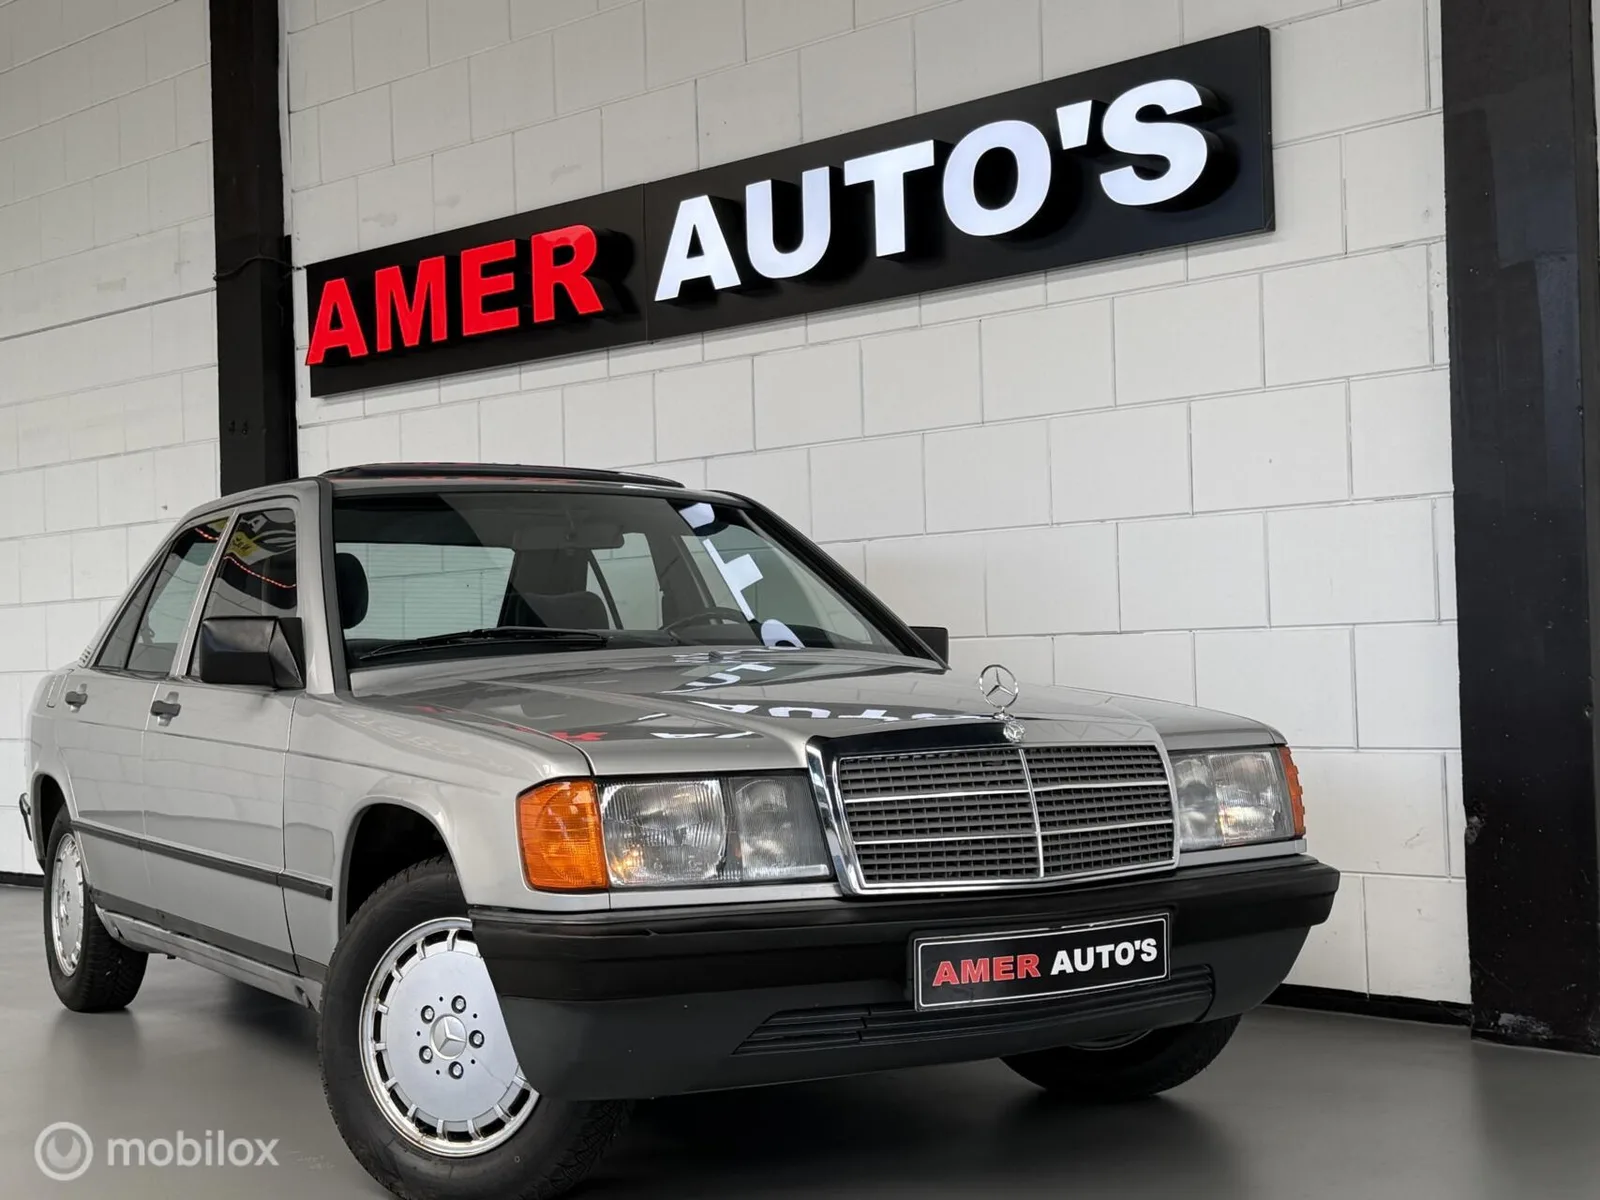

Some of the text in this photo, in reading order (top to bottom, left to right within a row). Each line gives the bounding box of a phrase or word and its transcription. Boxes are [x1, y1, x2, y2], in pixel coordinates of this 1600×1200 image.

[306, 79, 1209, 366] AMER AUTO'S
[932, 938, 1158, 987] AMER AUTO'S
